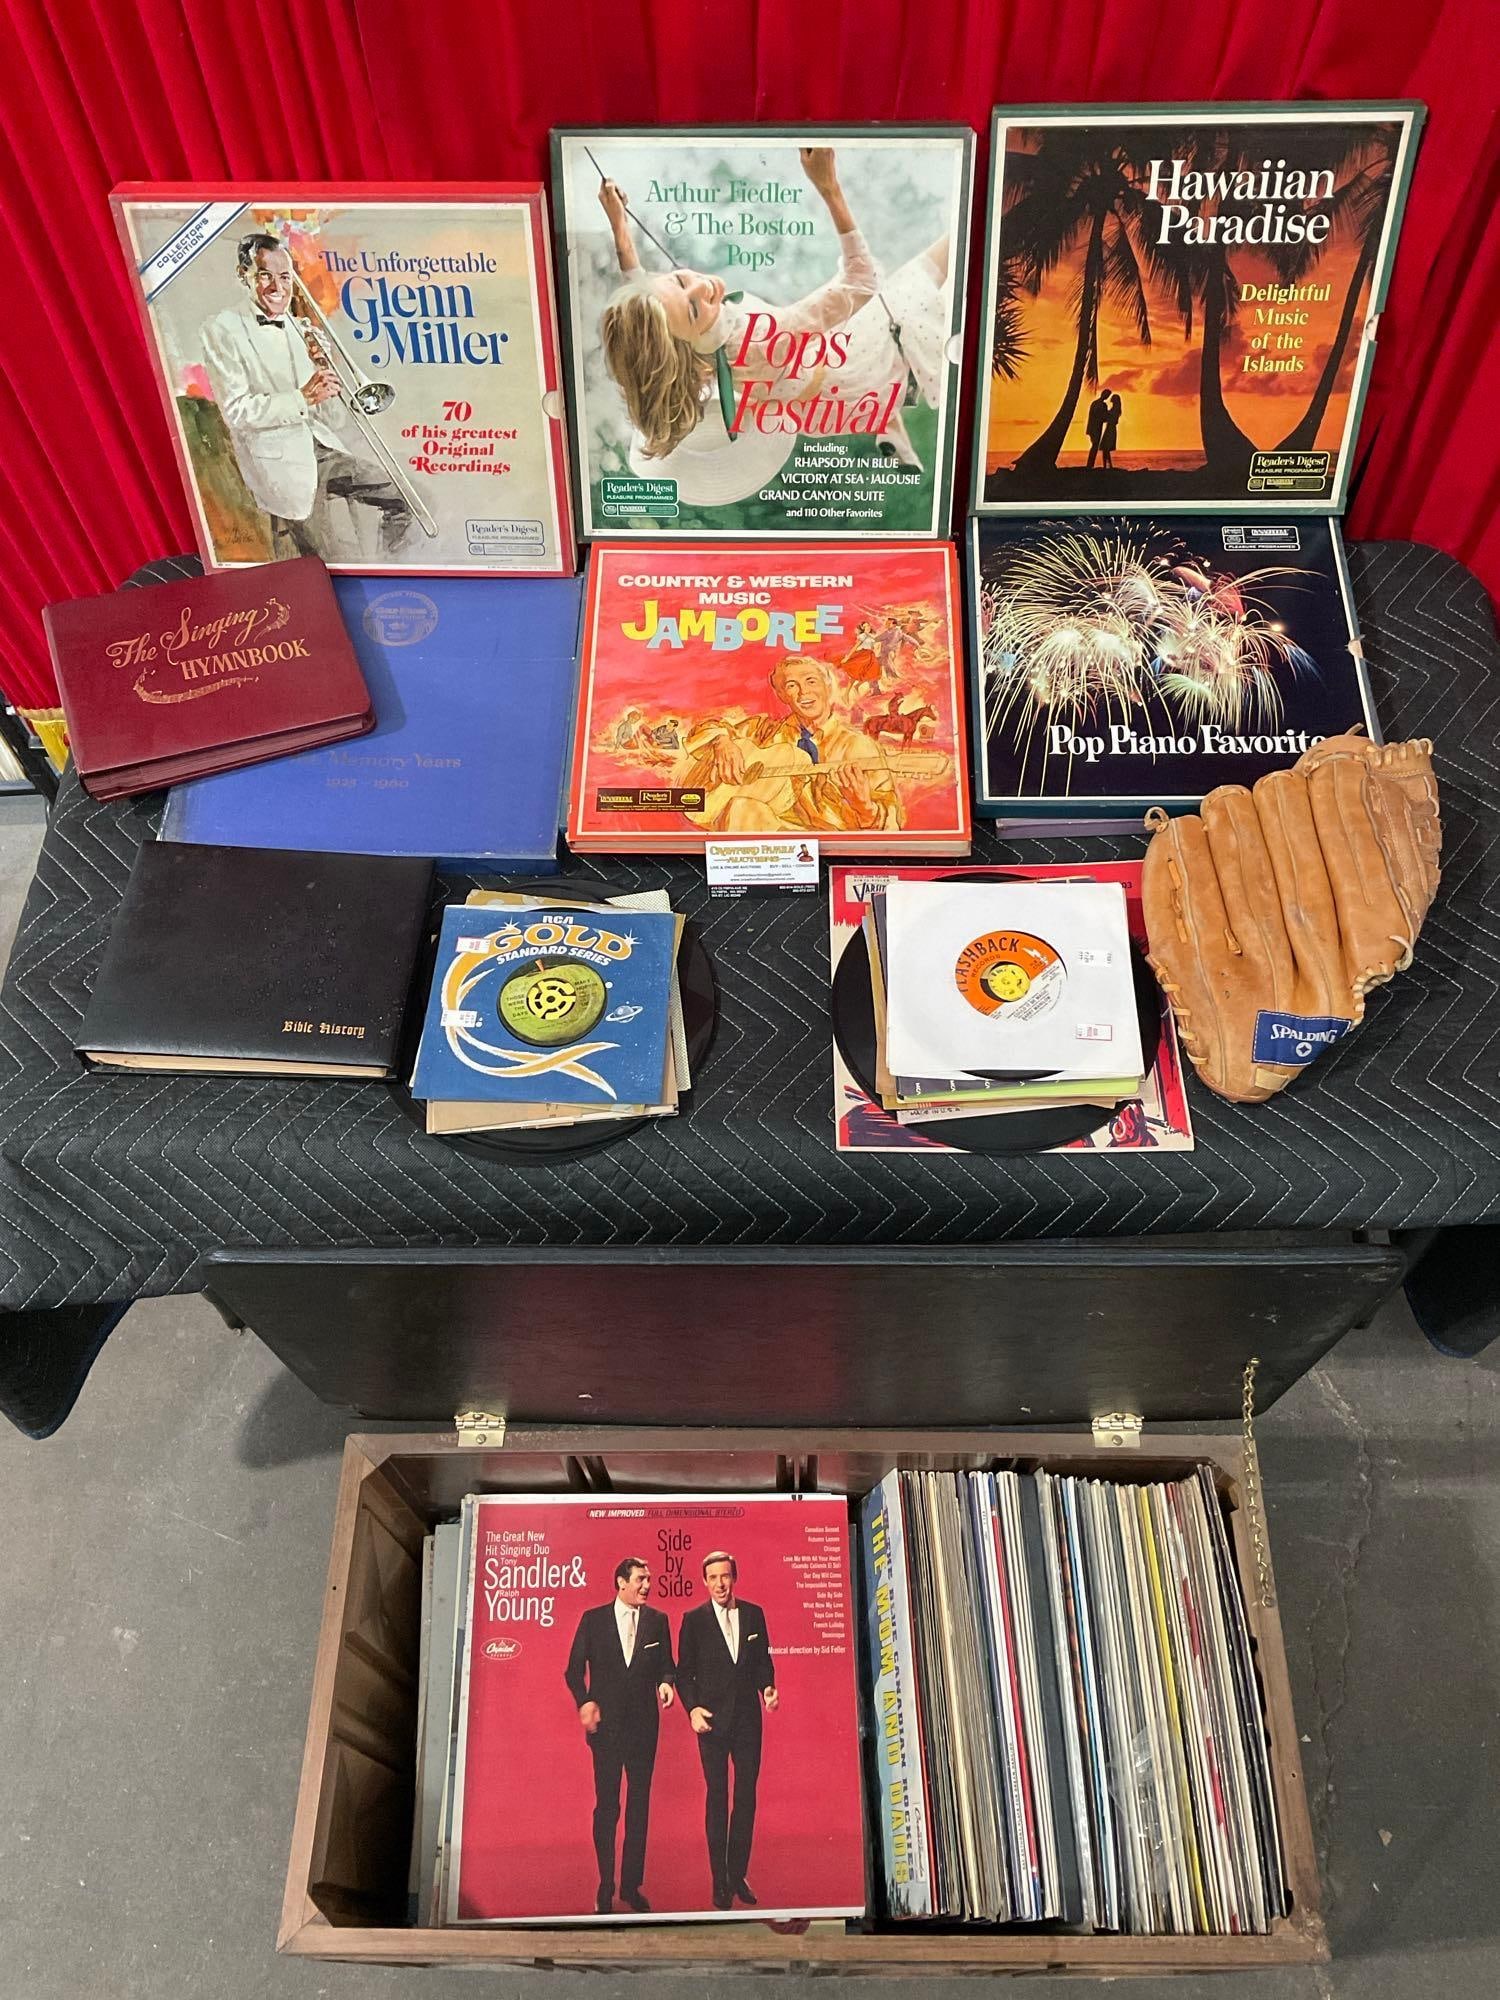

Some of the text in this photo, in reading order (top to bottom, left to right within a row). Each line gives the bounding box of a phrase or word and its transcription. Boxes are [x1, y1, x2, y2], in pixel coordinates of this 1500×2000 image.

[1145, 159, 1335, 201] Hawaiian
[645, 179, 803, 204] Arthur Fiedler
[664, 212, 815, 236] & The Boston
[1155, 204, 1331, 245] Paradise
[156, 217, 209, 269] COLLECTOR'S
[171, 232, 205, 264] EDITION
[318, 250, 497, 284] The Unforgettable
[727, 243, 775, 271] Pops
[1240, 283, 1332, 306] Delightful
[341, 275, 476, 343] Glenn
[1254, 308, 1310, 326] Music
[370, 320, 509, 368] Miller
[734, 312, 853, 379] Pops
[1251, 333, 1304, 353] of the
[1242, 355, 1305, 373] Islands
[442, 401, 472, 422] 70
[729, 380, 902, 435] Festival
[401, 426, 518, 442] of his greatest
[422, 442, 495, 459] Original
[803, 443, 849, 456] including:
[409, 456, 512, 475] Recordings
[794, 457, 899, 469] RHAPSODY IN BLUE
[1257, 456, 1327, 468] Reader's Digest
[606, 482, 673, 495] Reader's Digest
[781, 473, 921, 485] VICTORY AT SEA JALOUSIE
[758, 490, 885, 501] GRAND CANYON SUITE
[786, 508, 883, 518] and 110 Other Favorites
[471, 523, 538, 535] Reader's Digest
[617, 575, 853, 588] COUNTRY & WESTERN
[698, 591, 771, 605] MUSIC
[620, 599, 844, 652] JAMBOREE
[105, 606, 270, 669] The Singing
[180, 638, 311, 681] HYMNBOOK
[1049, 724, 1105, 763] Pop
[1109, 724, 1198, 756] Piano
[853, 882, 887, 901] VARSIT
[542, 915, 574, 925] RCA
[489, 923, 632, 961] GOLD
[496, 945, 568, 965] STANDARD
[569, 945, 612, 967] SERIES
[281, 1020, 314, 1033] Bible
[1270, 1023, 1338, 1044] SPALDING
[589, 1509, 606, 1518] NEW
[607, 1509, 646, 1517] IMPROVED
[485, 1530, 545, 1543] The Great New
[657, 1529, 692, 1552] Side
[871, 1508, 887, 1576] THE
[485, 1543, 550, 1558] Hit Singing Duo
[500, 1557, 518, 1566] Tony
[665, 1550, 684, 1577] by
[500, 1589, 520, 1597] Ralph
[658, 1574, 694, 1598] Side
[484, 1590, 555, 1627] Young
[875, 1583, 895, 1677] MOM
[486, 1642, 516, 1654] Capitol
[767, 1645, 846, 1655] Musical direction by Sid Feller
[882, 1690, 900, 1766] AND
[893, 1651, 907, 1768] CANADIAN
[902, 1778, 915, 1881] ROCKIES
